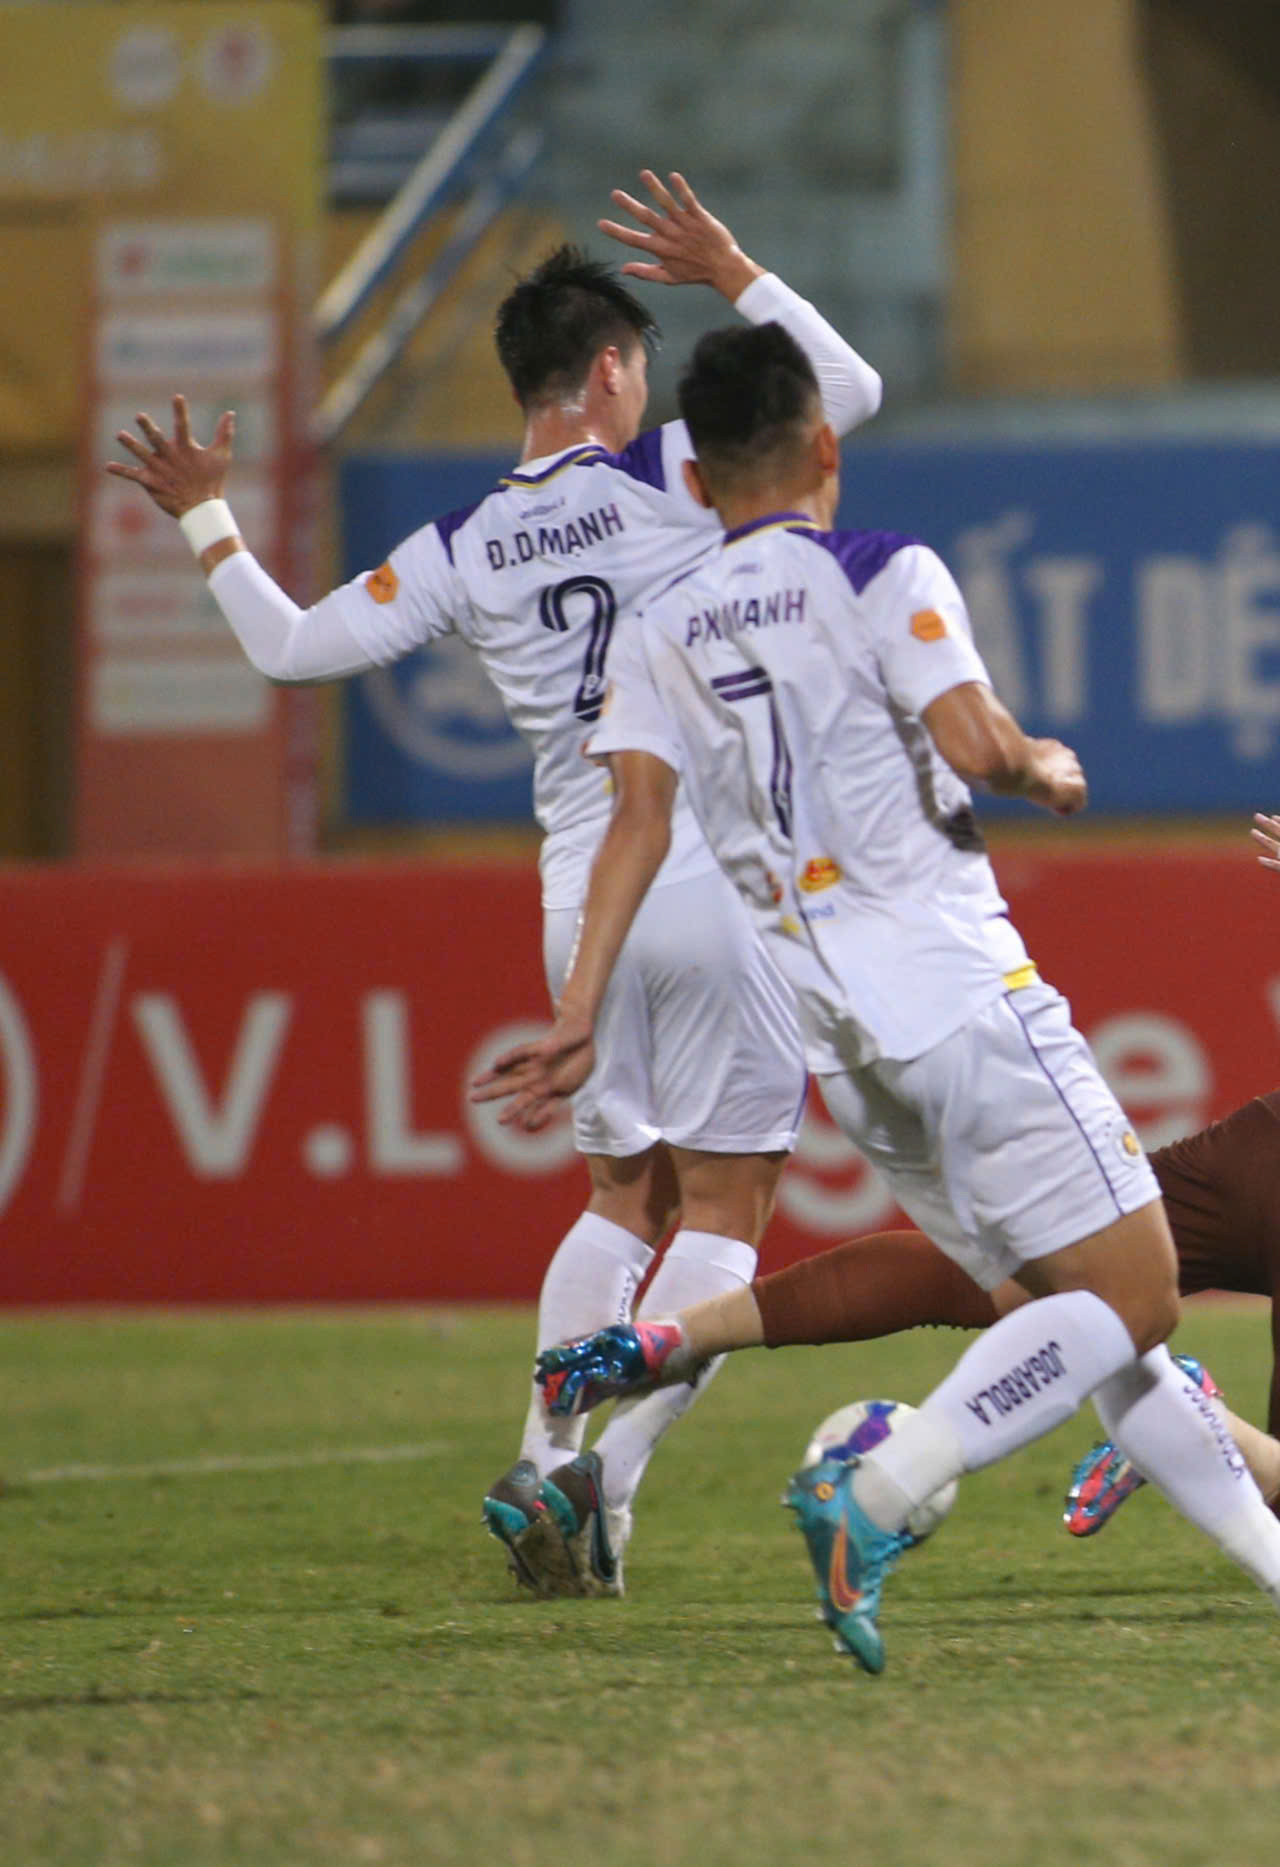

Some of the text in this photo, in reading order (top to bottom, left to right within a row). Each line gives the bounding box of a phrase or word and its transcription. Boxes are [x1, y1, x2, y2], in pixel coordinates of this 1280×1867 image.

[539, 575, 616, 721] 2
[710, 666, 793, 838] 7
[964, 1340, 1067, 1426] JOGARBOLA
